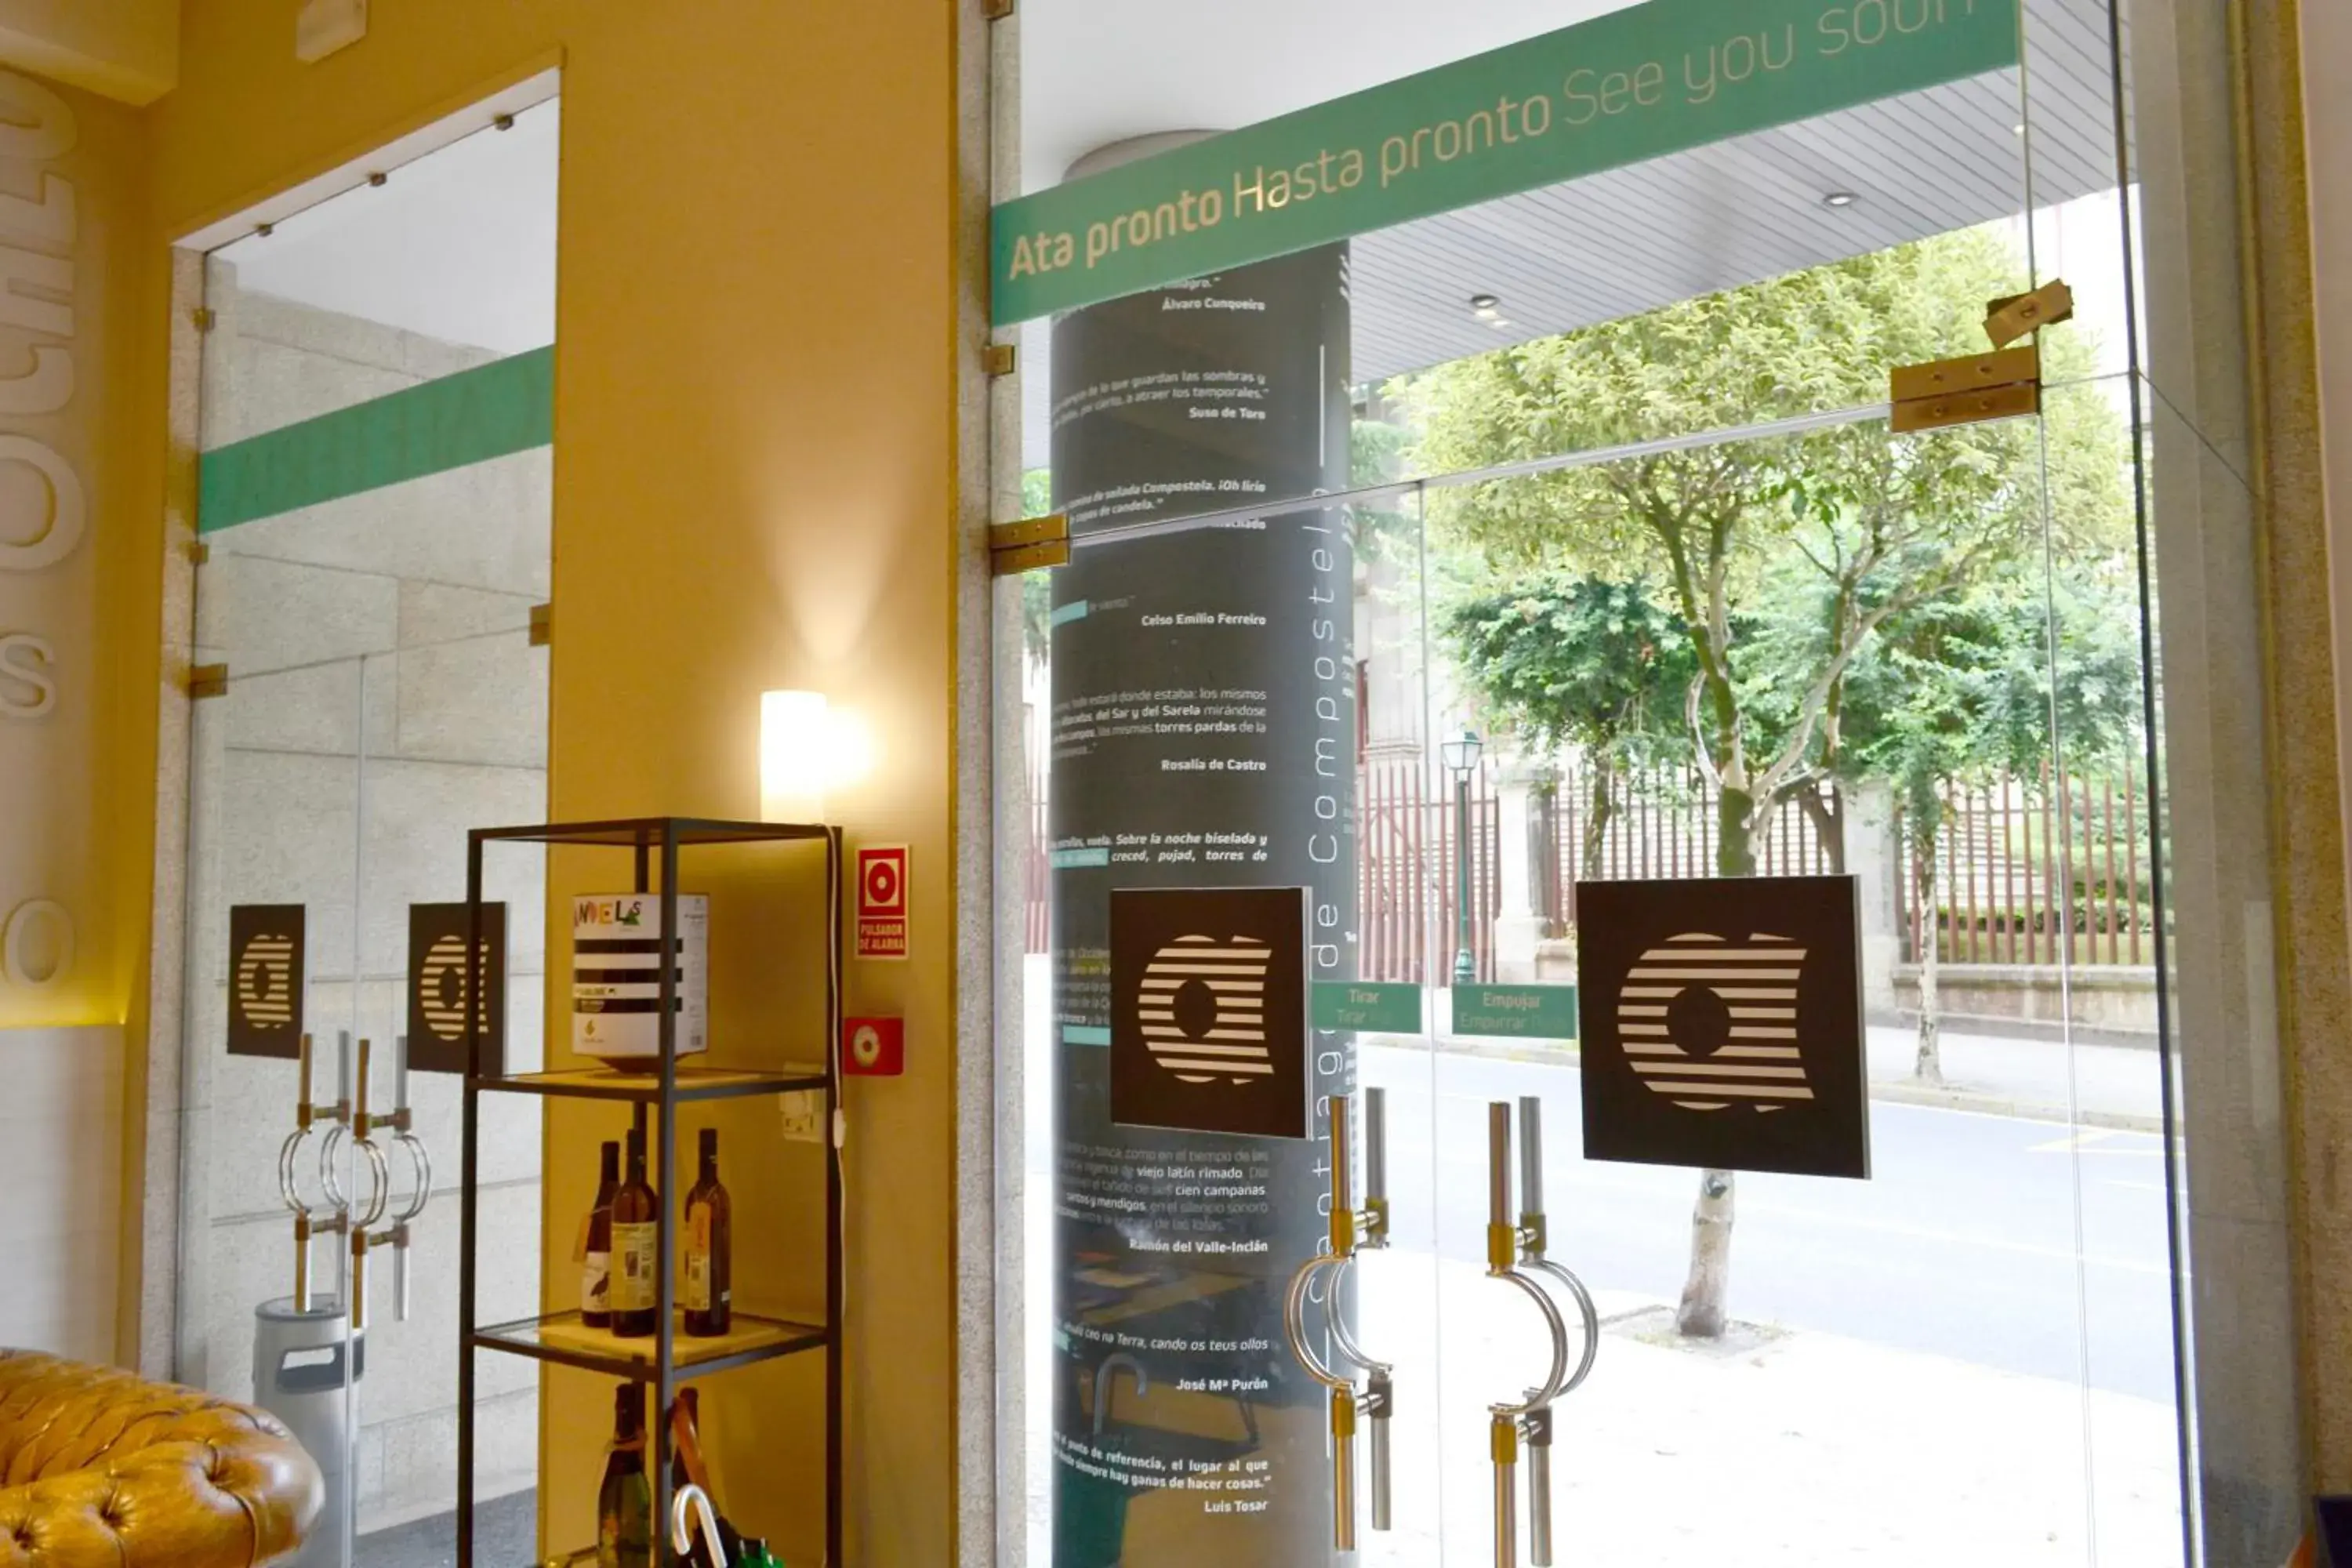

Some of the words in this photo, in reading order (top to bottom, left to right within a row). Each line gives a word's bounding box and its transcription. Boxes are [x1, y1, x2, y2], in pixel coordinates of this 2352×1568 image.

[1008, 234, 1074, 281] Ata
[1086, 188, 1223, 268] pronto
[1233, 147, 1364, 218] Hasta
[1380, 93, 1552, 190] pronto
[1563, 62, 1664, 125] See
[1684, 24, 1794, 104] you
[1162, 296, 1202, 310] Álvaro
[1204, 297, 1265, 312] Cunqueiro
[1203, 371, 1254, 383] sombras
[1189, 407, 1219, 420] Suso
[1221, 408, 1236, 419] de
[1240, 408, 1265, 420] Toro
[1241, 480, 1266, 493] lirio
[1142, 615, 1173, 626] Celso
[1176, 613, 1215, 626] Emilio
[1218, 612, 1267, 626] Ferreiro
[1200, 688, 1218, 699] los
[1221, 689, 1267, 699] mismos
[1132, 709, 1139, 720] y
[1142, 705, 1160, 717] del
[1163, 705, 1201, 717] Sarela
[1203, 705, 1267, 717] mirándose
[1155, 723, 1192, 734] torres
[1195, 722, 1237, 735] pardas
[1239, 722, 1254, 733] de
[1256, 722, 1267, 733] la
[1162, 758, 1206, 770] Rosalía
[1209, 759, 1224, 770] de
[1227, 759, 1267, 771] Castro
[1116, 833, 1147, 845] Sobre
[1150, 833, 1162, 844] la
[1164, 833, 1201, 844] noche
[1204, 832, 1255, 845] biselada
[1258, 836, 1268, 847] y
[1111, 851, 1149, 863] creced,
[1157, 850, 1196, 863] pujad,
[1205, 849, 1244, 861] torres
[1252, 849, 1268, 861] de
[1311, 904, 1339, 967] de
[1348, 989, 1380, 1004] Tirar
[1483, 992, 1541, 1011] Empujar
[1461, 1013, 1526, 1029] Empurrar
[1136, 1165, 1164, 1179] viejo
[1167, 1165, 1196, 1178] latín
[1175, 1183, 1201, 1196] cien
[1203, 1185, 1266, 1199] campanas
[1129, 1238, 1169, 1252] Ramón
[1172, 1240, 1192, 1252] del
[1195, 1239, 1269, 1254] Valle-Inclán
[1116, 1332, 1148, 1349] Terra,
[1150, 1339, 1187, 1351] cando
[1190, 1341, 1206, 1351] os
[1209, 1340, 1237, 1351] teus
[1240, 1338, 1269, 1350] ollos
[1176, 1378, 1206, 1391] José
[1106, 1450, 1167, 1472] referencia,
[1171, 1459, 1183, 1471] el
[1189, 1458, 1221, 1473] lugar
[1228, 1459, 1240, 1471] al
[1246, 1459, 1269, 1472] que
[1109, 1467, 1129, 1485] hay
[1131, 1475, 1167, 1488] ganas
[1169, 1476, 1185, 1488] de
[1188, 1476, 1221, 1490] hacer
[1203, 1500, 1232, 1512] Luis
[1234, 1500, 1268, 1513] Tosar
